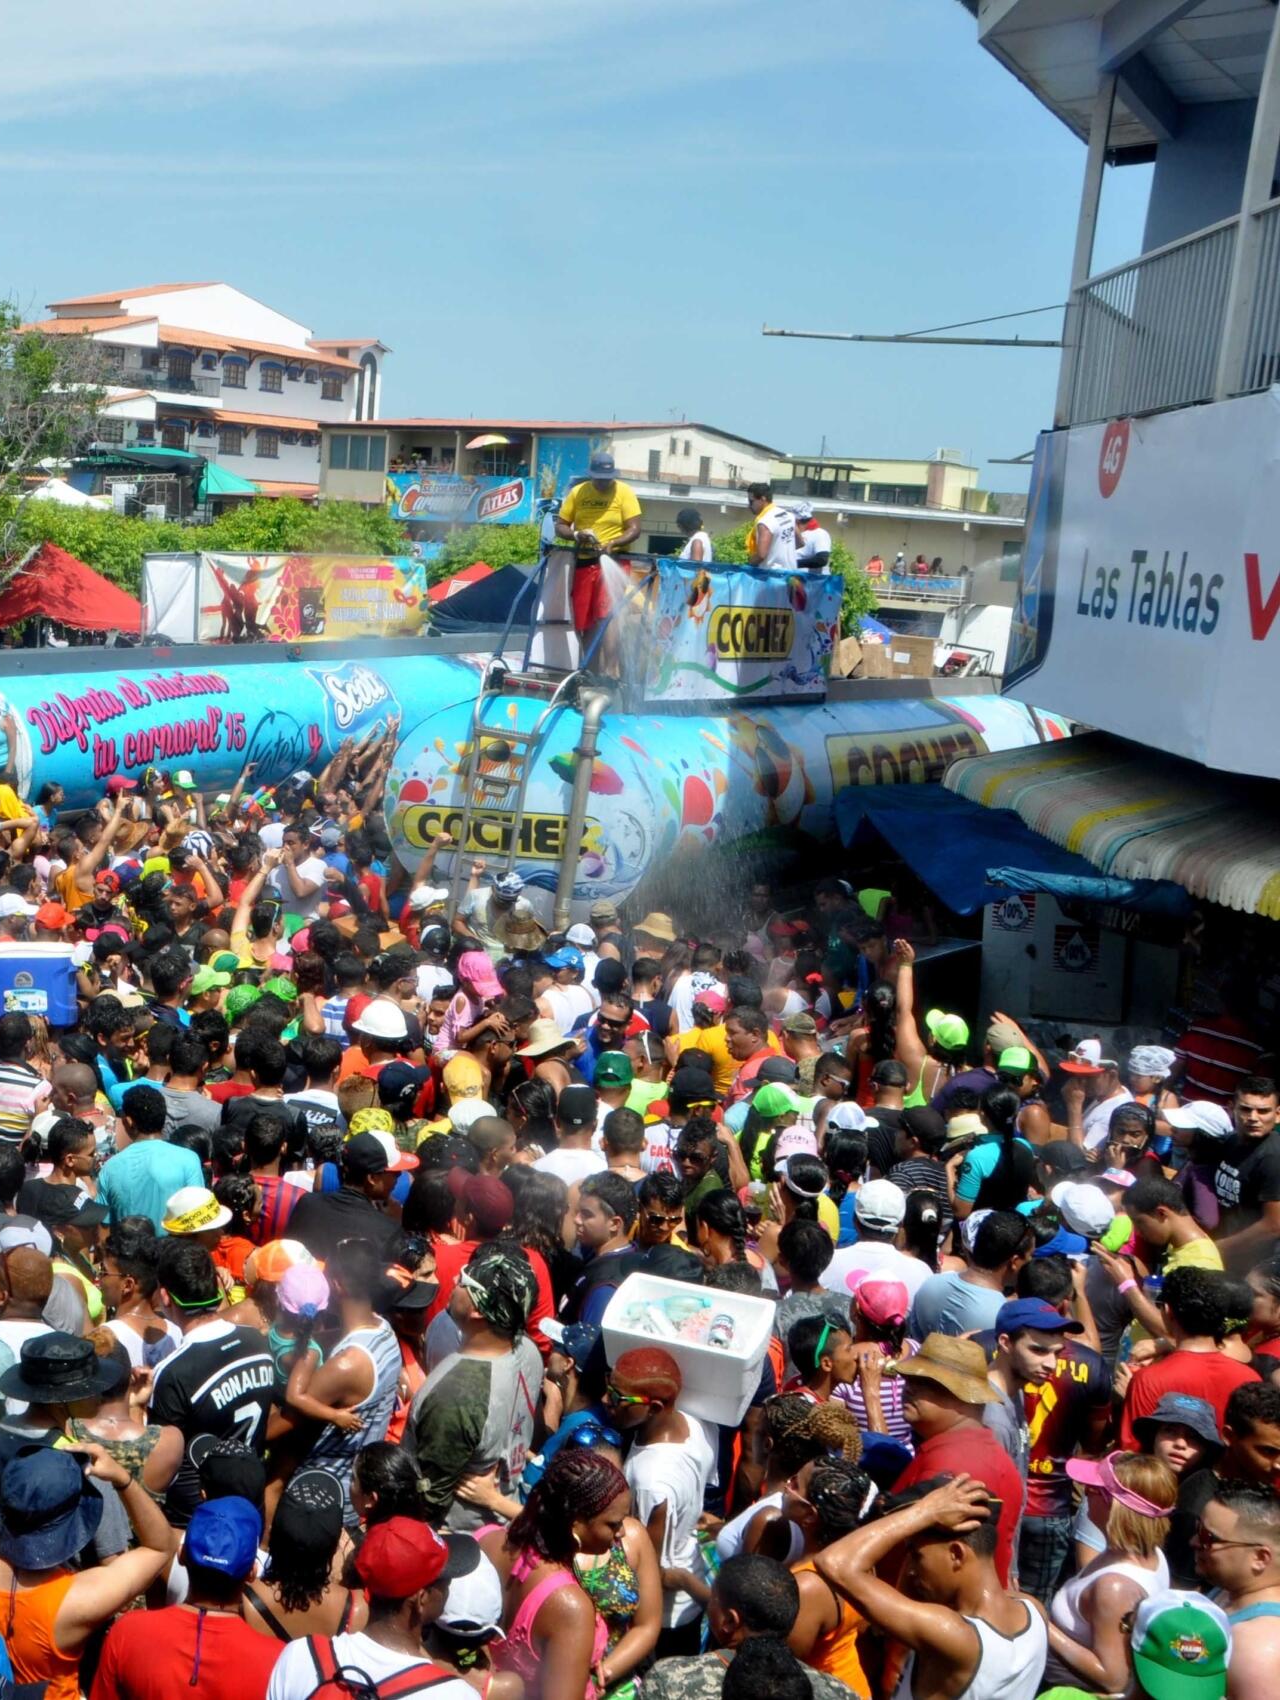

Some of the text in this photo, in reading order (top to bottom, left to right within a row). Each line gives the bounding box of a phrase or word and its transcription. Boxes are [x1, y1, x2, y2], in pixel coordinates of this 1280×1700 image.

[1102, 436, 1122, 475] 4G
[479, 487, 520, 516] ATLAS
[1077, 548, 1120, 620] Las
[1128, 550, 1224, 636] Tablas
[716, 612, 790, 653] COCHEZ
[325, 666, 386, 727] Scott
[27, 687, 127, 753] Disfruta
[94, 732, 119, 779] tu
[210, 1365, 274, 1410] RONALDO
[234, 1401, 262, 1446] 7
